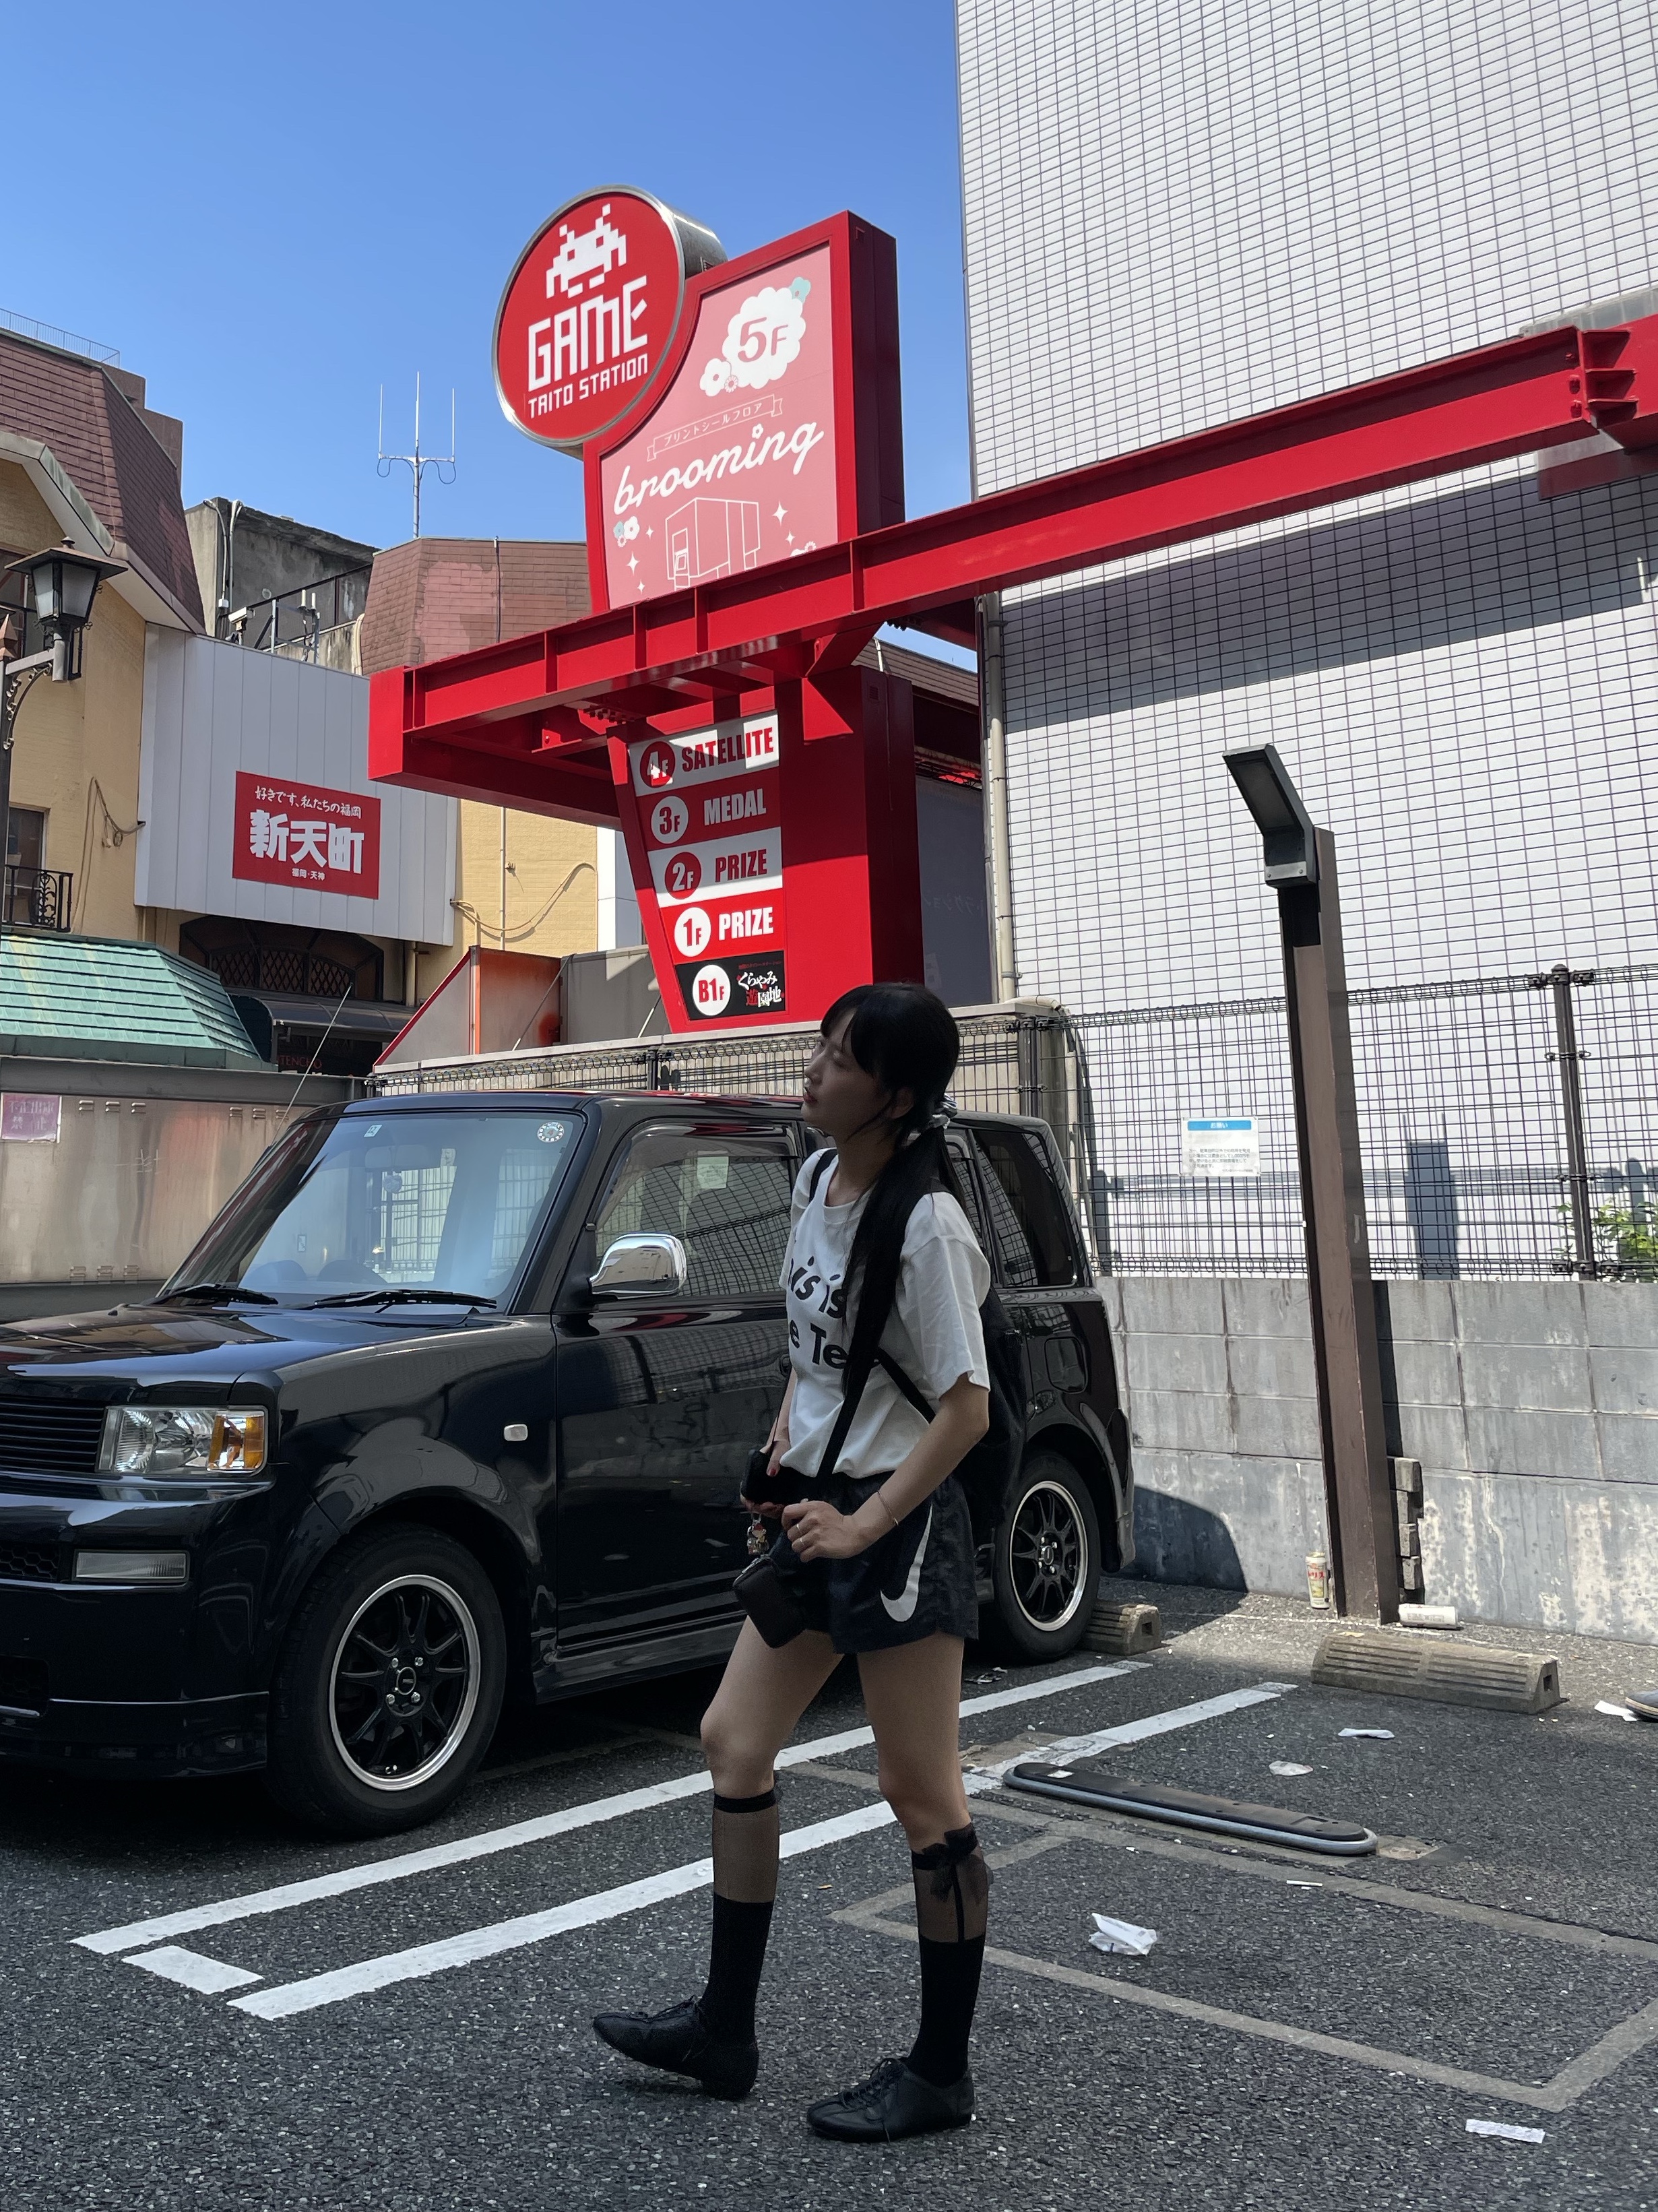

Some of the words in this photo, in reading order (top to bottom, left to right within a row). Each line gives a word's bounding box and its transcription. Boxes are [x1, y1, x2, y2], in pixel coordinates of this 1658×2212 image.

[528, 275, 648, 392] GAME
[737, 317, 788, 362] 5F
[528, 383, 573, 419] TAITO
[579, 353, 648, 400] STATION
[664, 402, 763, 447] プリントシールフロア
[613, 421, 825, 515] brooming
[647, 751, 668, 779] 4F
[682, 727, 774, 772] SATELLITE
[255, 785, 362, 819] 好きです、私たちの福岡
[659, 807, 680, 835] 3F
[703, 788, 767, 826] MEDAL
[249, 809, 365, 874] 新天町
[672, 862, 694, 891] 2F
[715, 849, 767, 883] PRIZE
[683, 918, 702, 947] 1F
[718, 906, 774, 941] PRIZE
[698, 977, 725, 1003] B1F
[738, 971, 778, 990] くらやみ
[278, 1055, 323, 1070] TENCHO
